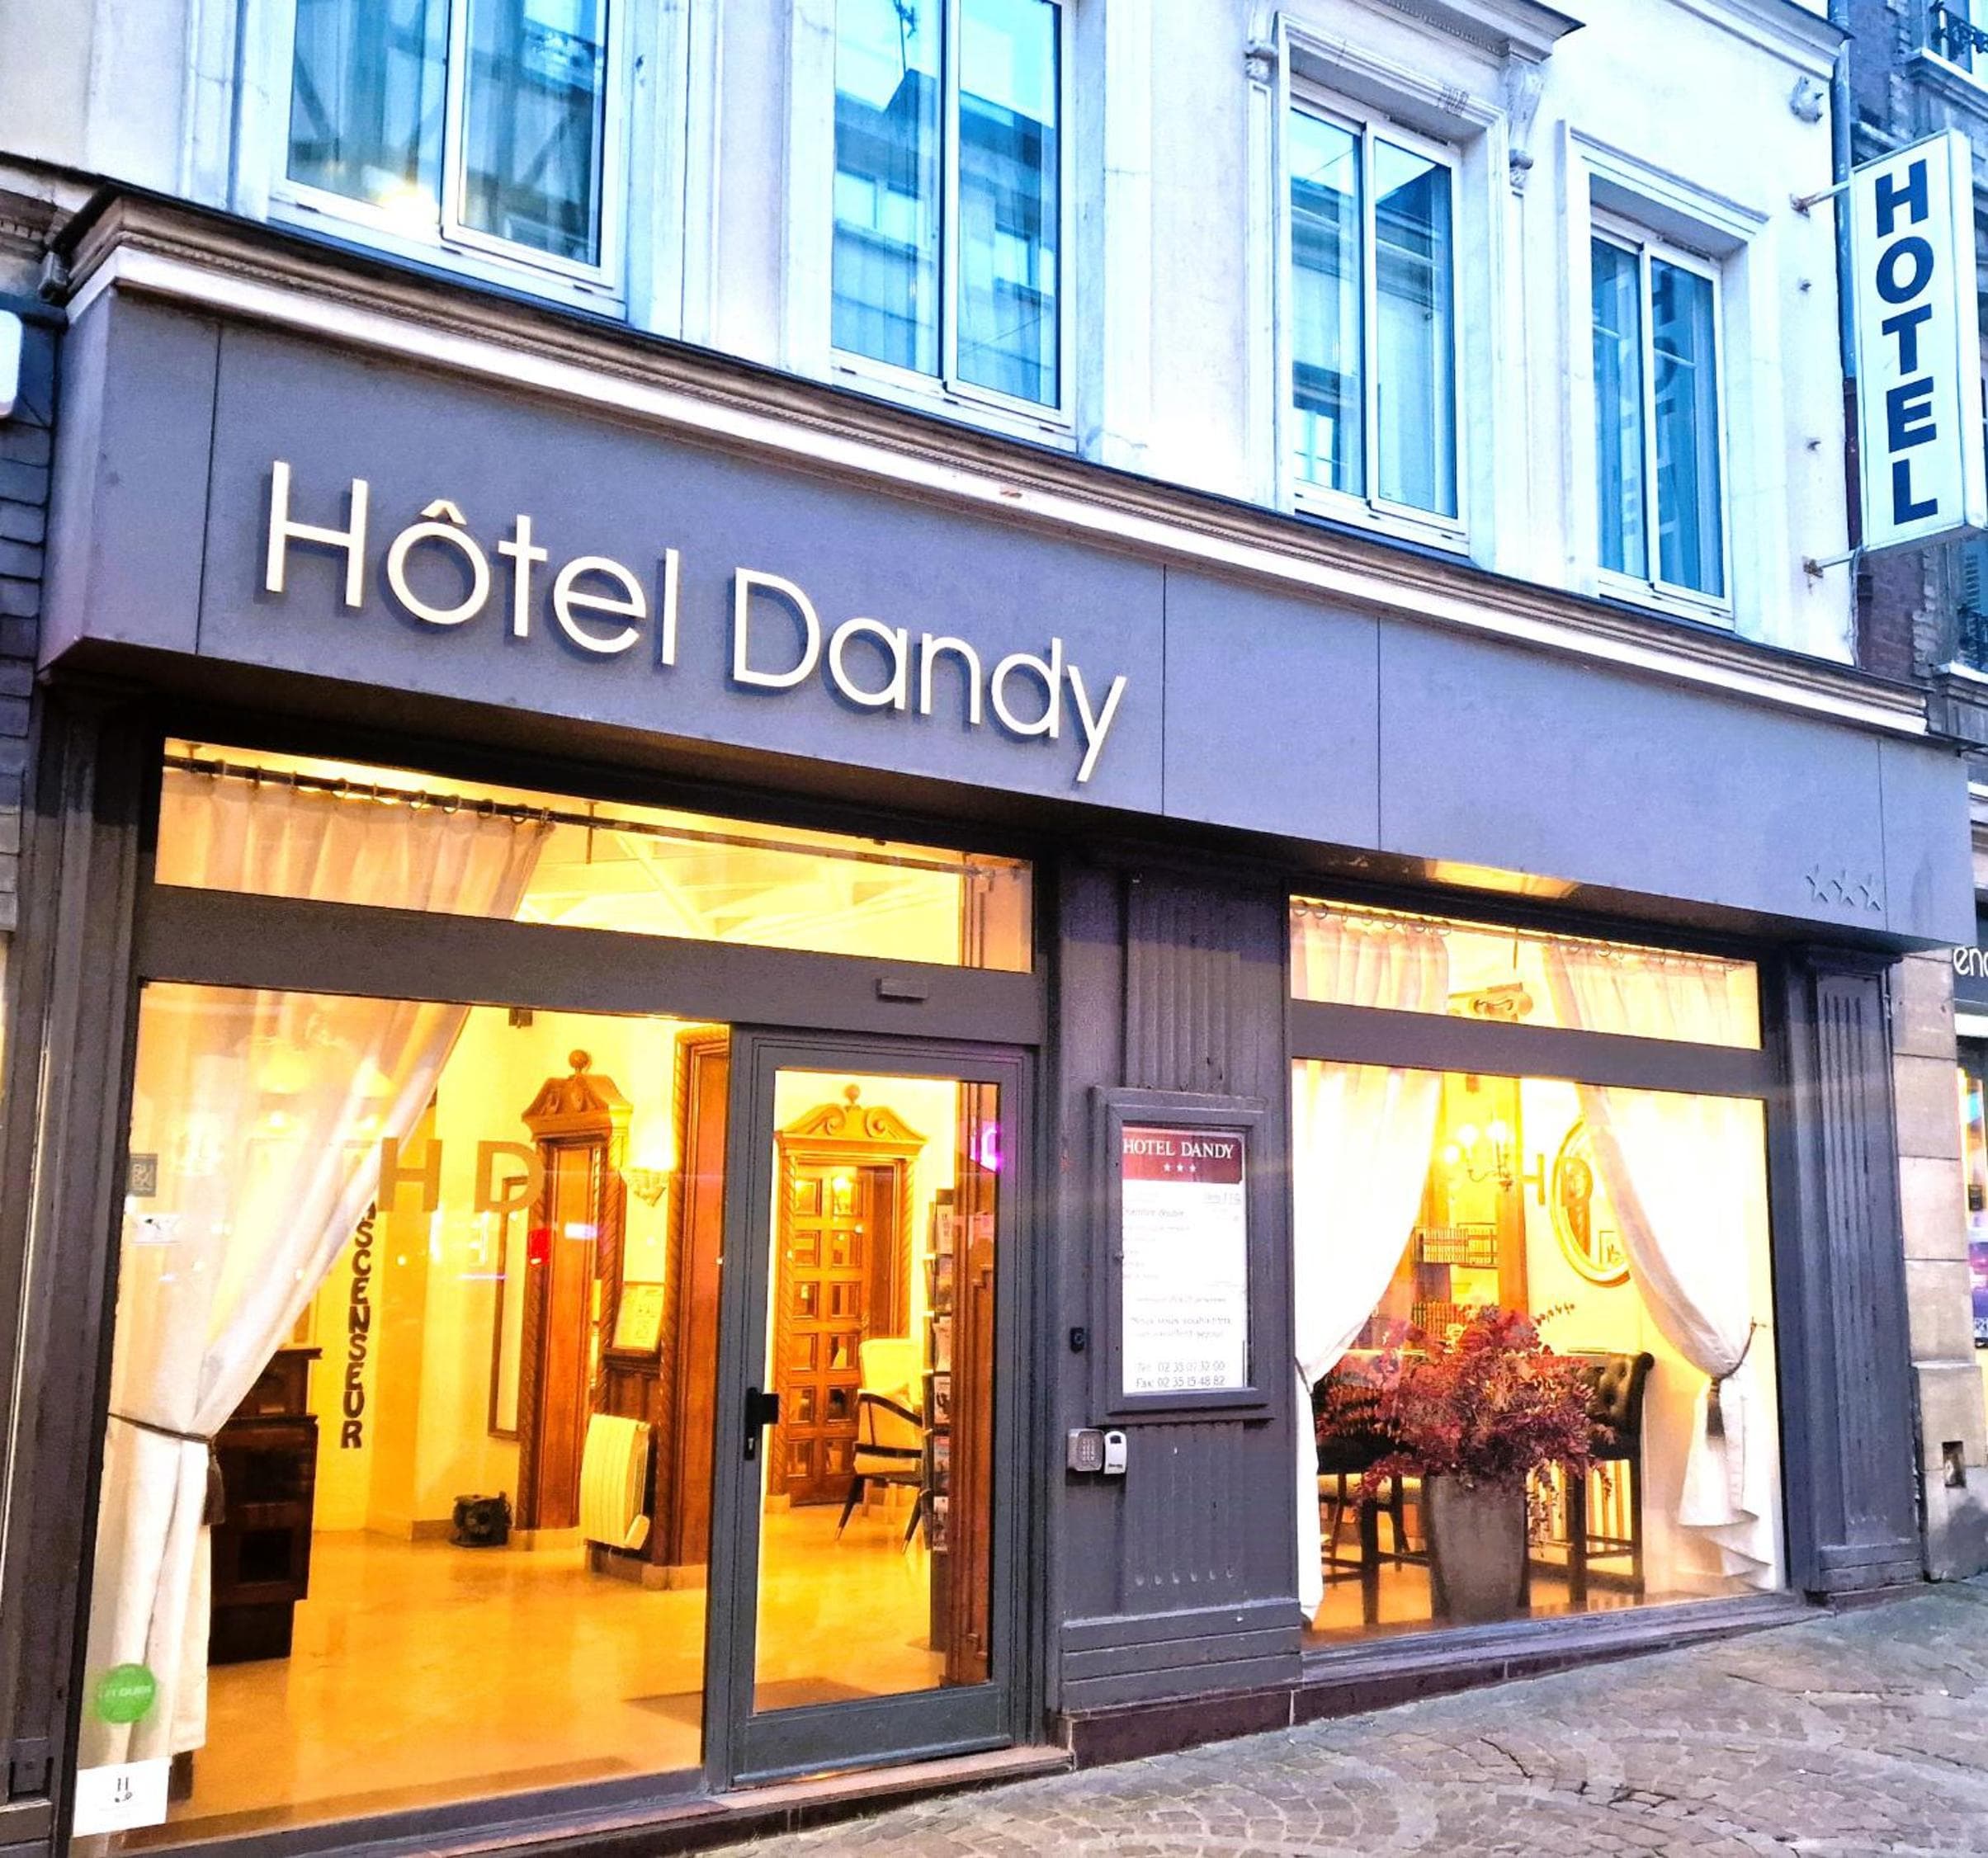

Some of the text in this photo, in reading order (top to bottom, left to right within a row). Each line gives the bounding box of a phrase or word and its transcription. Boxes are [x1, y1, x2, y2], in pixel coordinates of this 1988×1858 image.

[1875, 158, 1938, 526] HOTEL
[266, 460, 1126, 782] Hôtel Dandy
[1123, 1139, 1234, 1159] HOTEL DANDY
